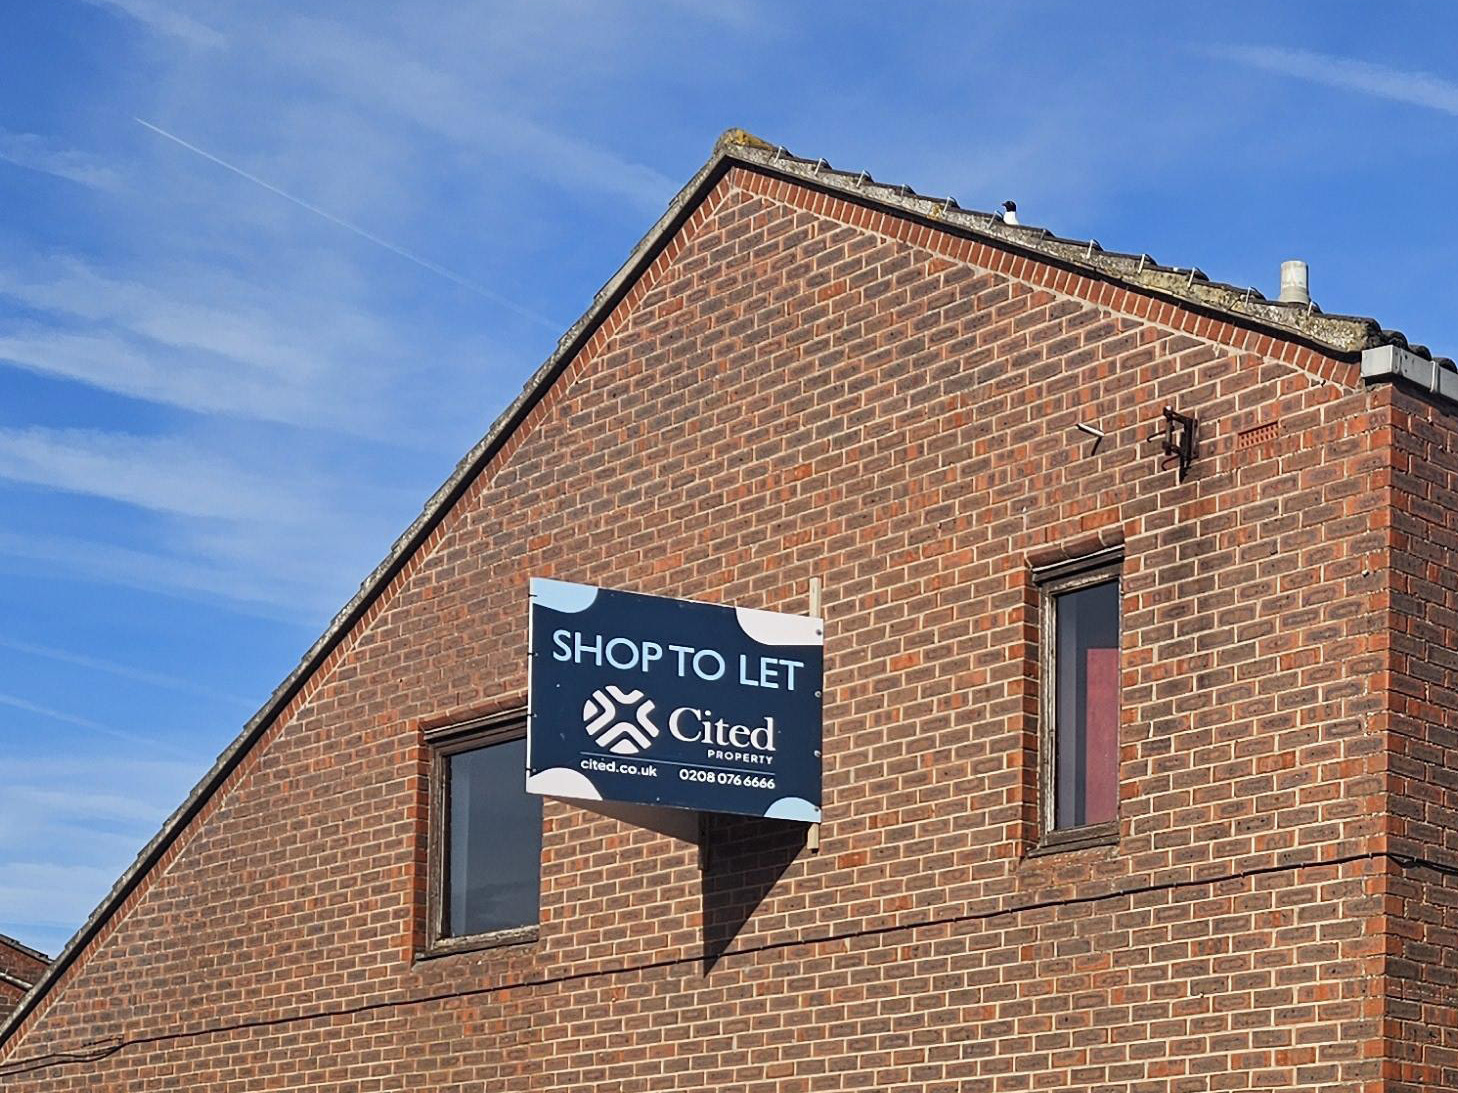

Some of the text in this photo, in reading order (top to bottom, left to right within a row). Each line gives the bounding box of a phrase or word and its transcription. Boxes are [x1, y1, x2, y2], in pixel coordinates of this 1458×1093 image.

[552, 629, 804, 691] SHOP TO LET
[668, 707, 776, 752] Cited
[580, 757, 776, 790] cited.co.uk 0208 076 6666
[707, 749, 774, 765] PROPERTY
